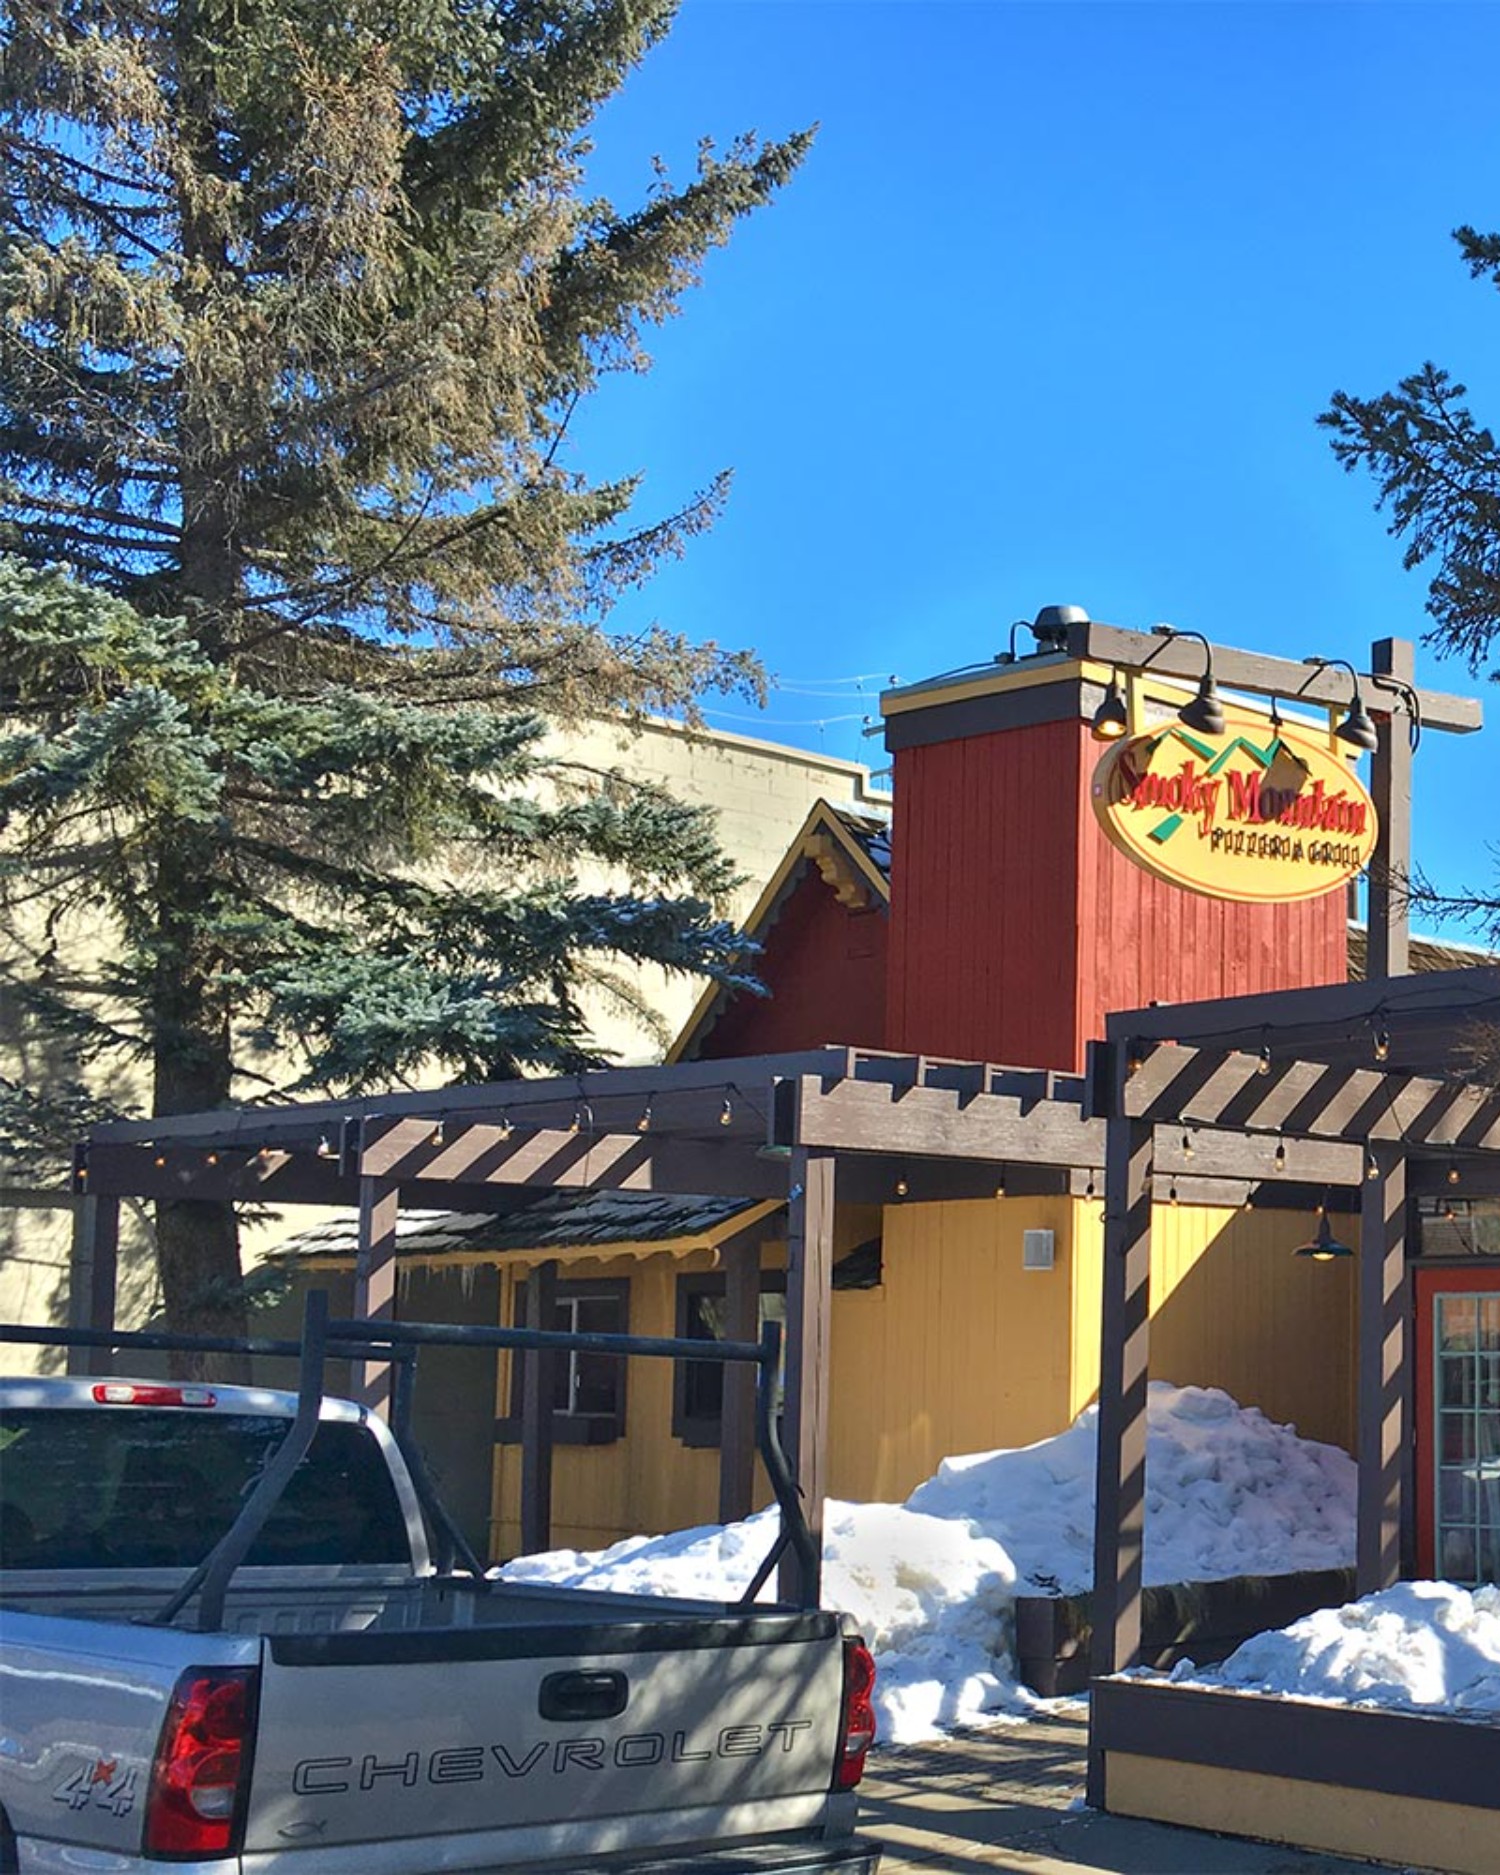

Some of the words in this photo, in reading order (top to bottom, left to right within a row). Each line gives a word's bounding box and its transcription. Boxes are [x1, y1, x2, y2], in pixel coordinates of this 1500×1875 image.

[1116, 750, 1222, 840] Smoky
[1225, 769, 1368, 837] Mountain
[1210, 827, 1304, 863] PIZZERIA
[293, 1720, 813, 1796] CHEVROLET
